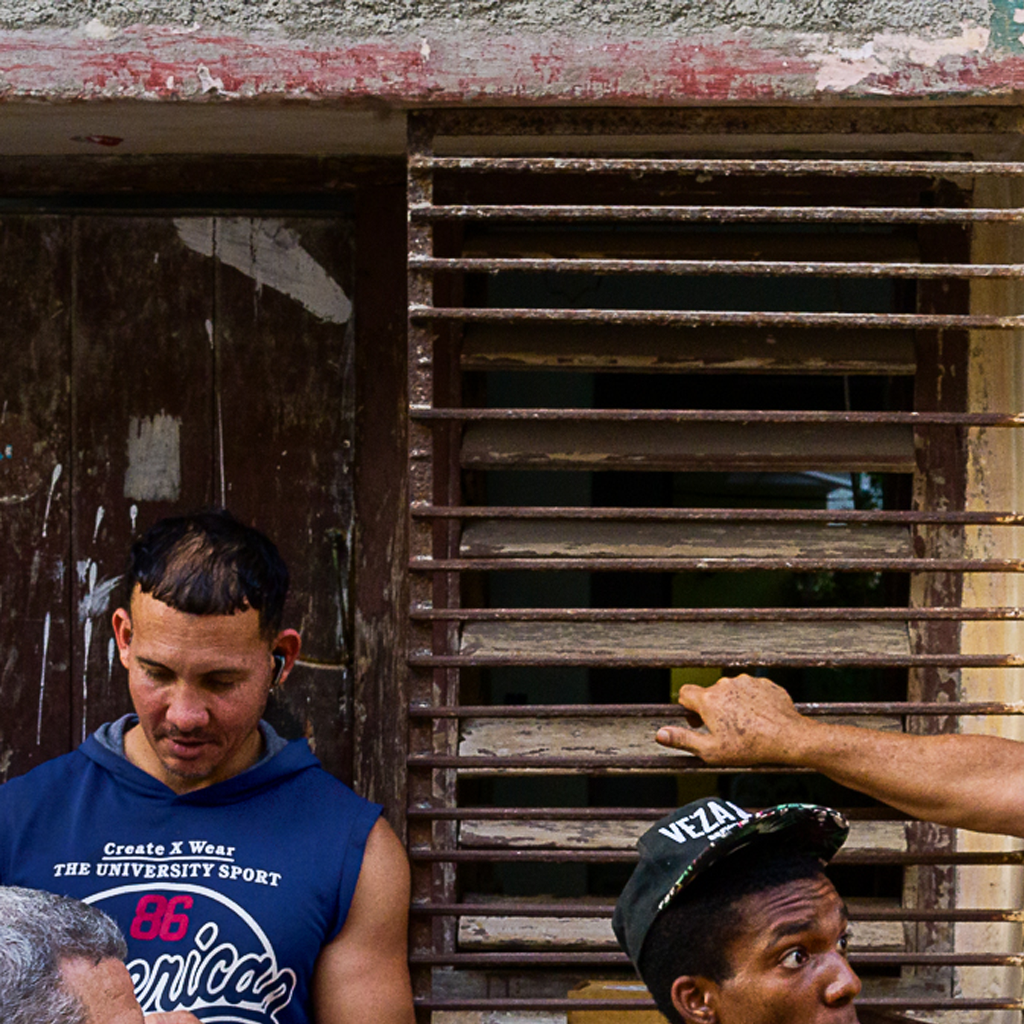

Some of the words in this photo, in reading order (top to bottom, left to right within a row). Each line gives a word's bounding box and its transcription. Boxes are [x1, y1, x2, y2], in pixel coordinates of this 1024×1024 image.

[104, 842, 165, 855] Create
[169, 841, 183, 855] X
[188, 840, 235, 856] Wear
[53, 862, 91, 878] THE
[96, 862, 215, 879] UNIVERSITY
[218, 864, 282, 887] SPORT
[129, 894, 194, 942] 86
